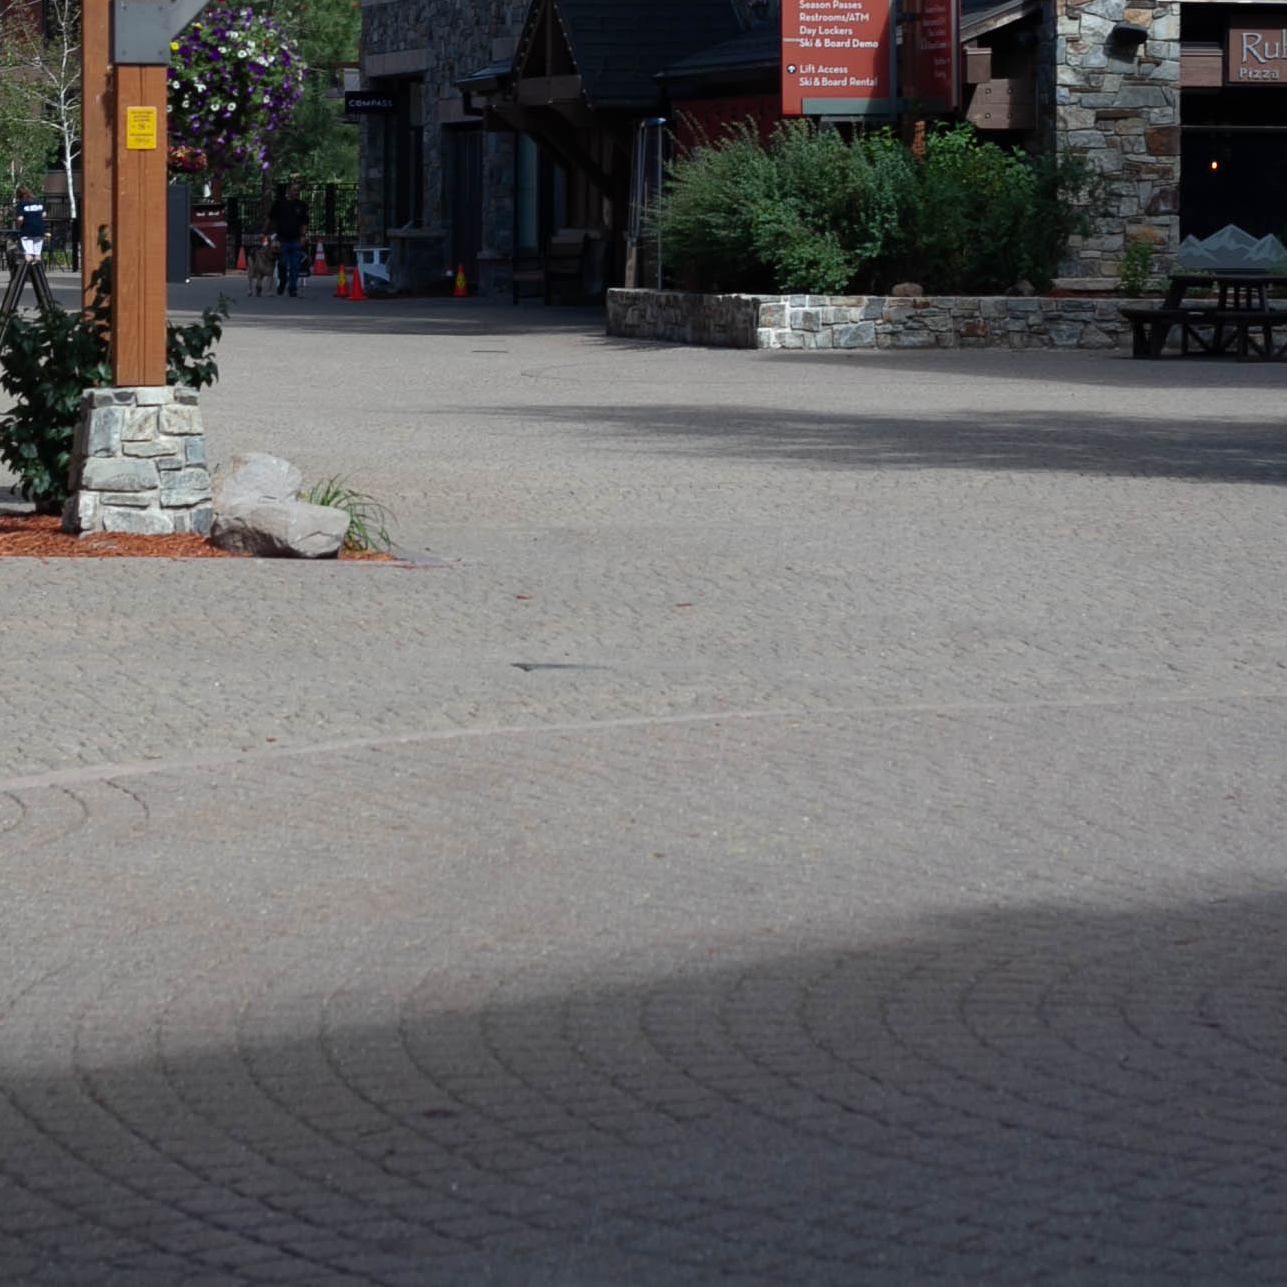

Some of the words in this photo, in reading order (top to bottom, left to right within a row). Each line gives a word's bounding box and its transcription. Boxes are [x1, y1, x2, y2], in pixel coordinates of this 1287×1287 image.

[799, 0, 831, 9] Season
[833, 0, 862, 9] Passes
[799, 12, 869, 23] Restrooms/ATM
[799, 25, 817, 37] Day
[818, 25, 853, 35] Lockers
[799, 38, 813, 48] Ski
[814, 38, 822, 48] &
[824, 38, 851, 48] Board
[852, 38, 879, 48] Demo
[799, 64, 815, 74] Lift
[817, 65, 849, 74] Access
[1239, 68, 1280, 81] Pizza
[799, 77, 812, 87] Ski
[813, 77, 820, 87] &
[821, 77, 848, 87] Board
[849, 77, 878, 87] Rental
